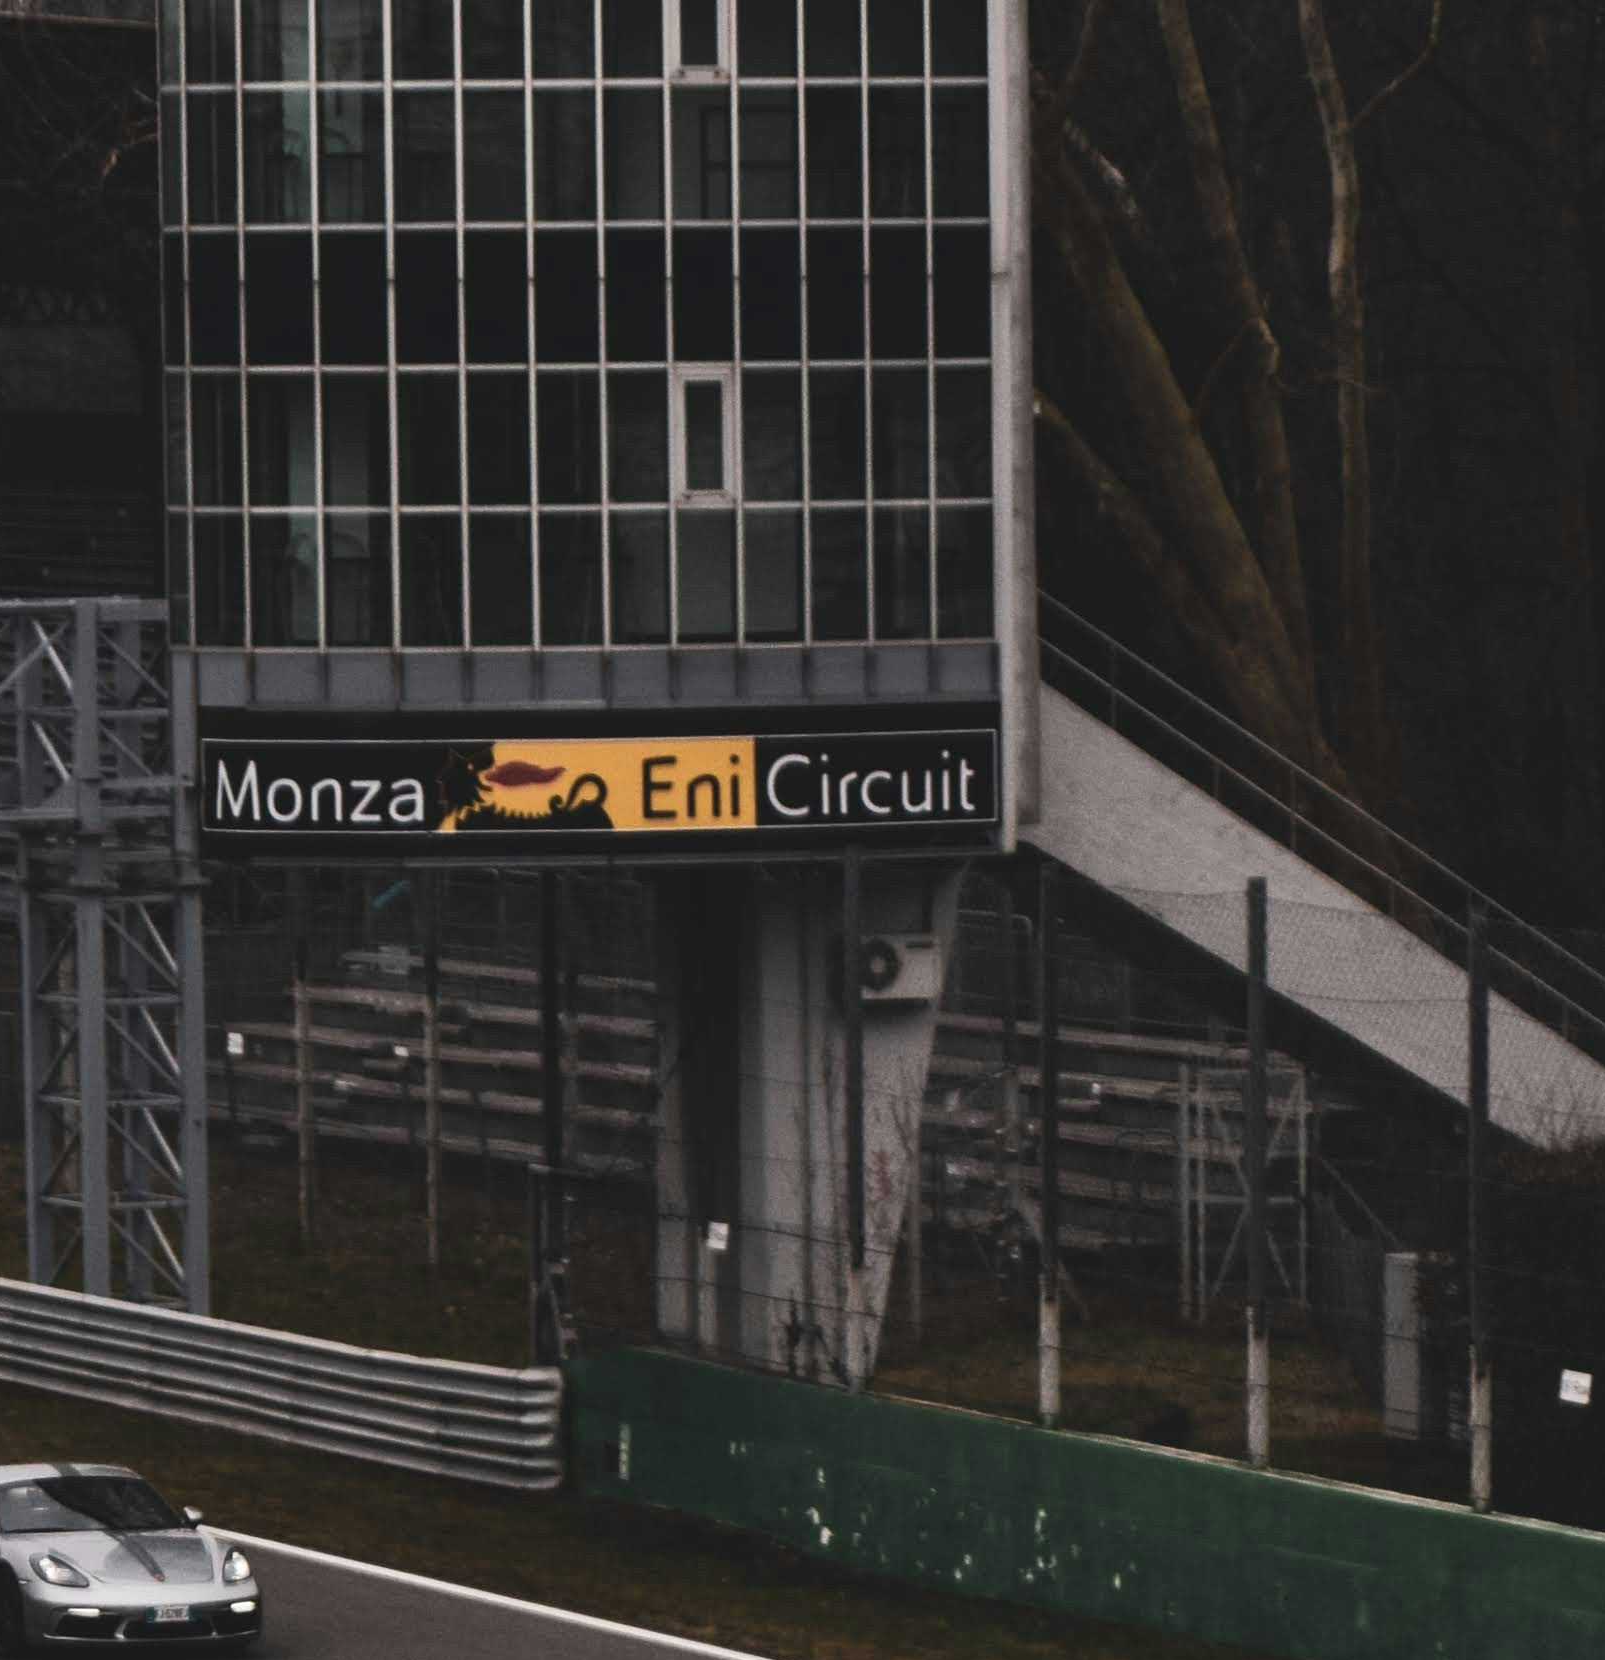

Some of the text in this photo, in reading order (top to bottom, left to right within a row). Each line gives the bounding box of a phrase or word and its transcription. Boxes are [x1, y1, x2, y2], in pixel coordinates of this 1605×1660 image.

[215, 748, 976, 825] Monza Eni Circuit
